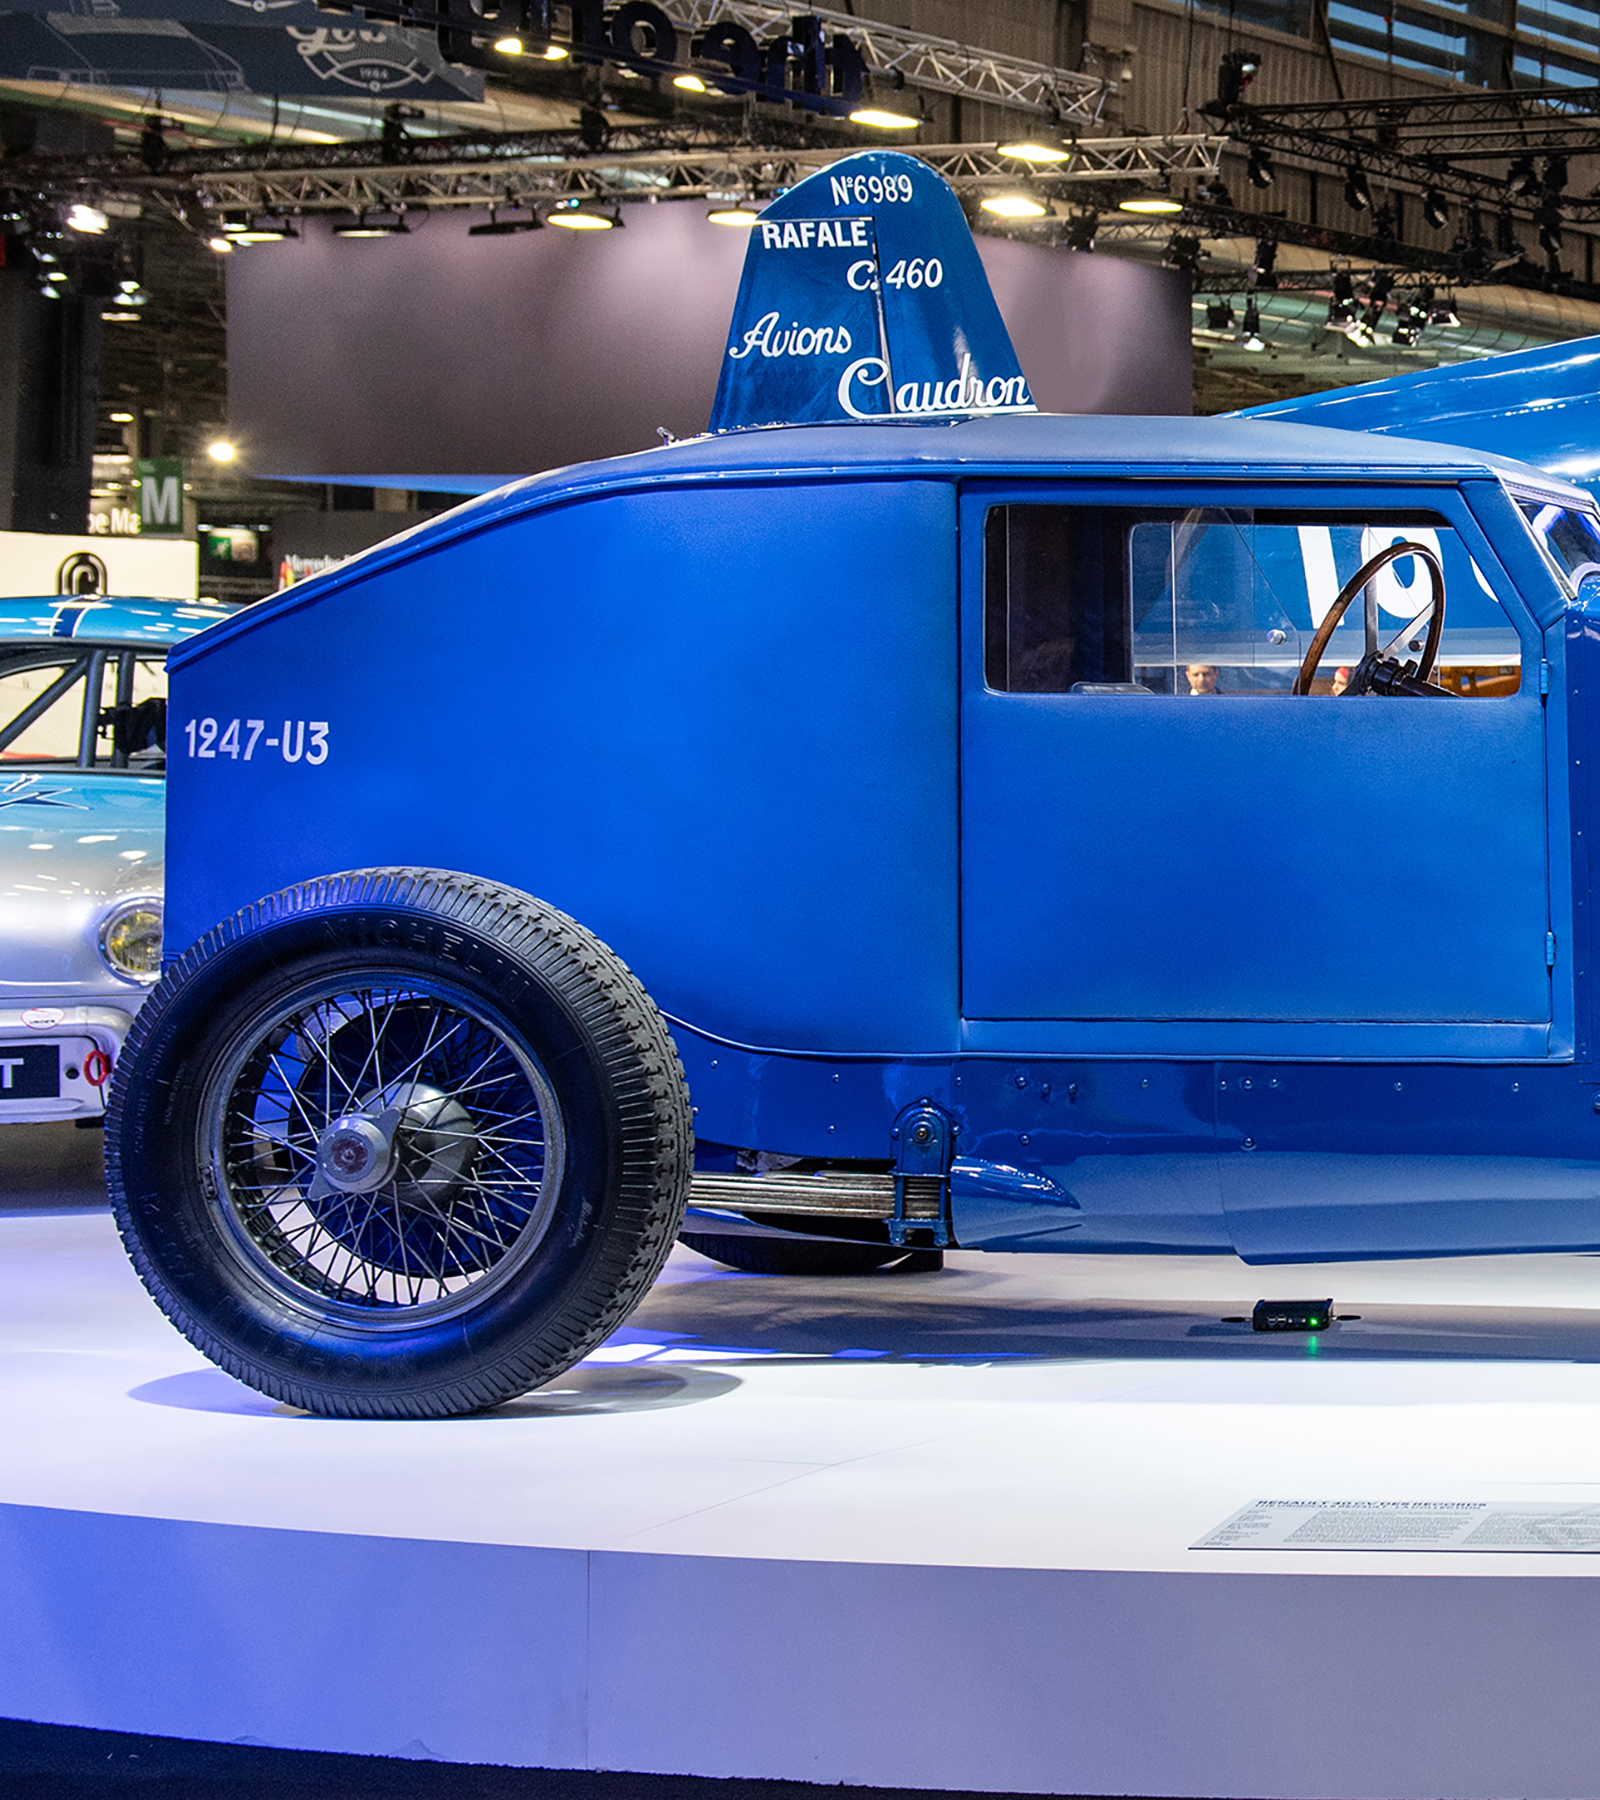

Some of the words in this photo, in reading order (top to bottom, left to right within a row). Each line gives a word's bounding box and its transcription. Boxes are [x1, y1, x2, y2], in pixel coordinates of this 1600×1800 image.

[761, 220, 868, 249] RAFALE
[729, 311, 852, 359] Avions
[837, 352, 1039, 420] Caudron
[141, 475, 178, 525] M
[184, 717, 330, 766] 1247-U3
